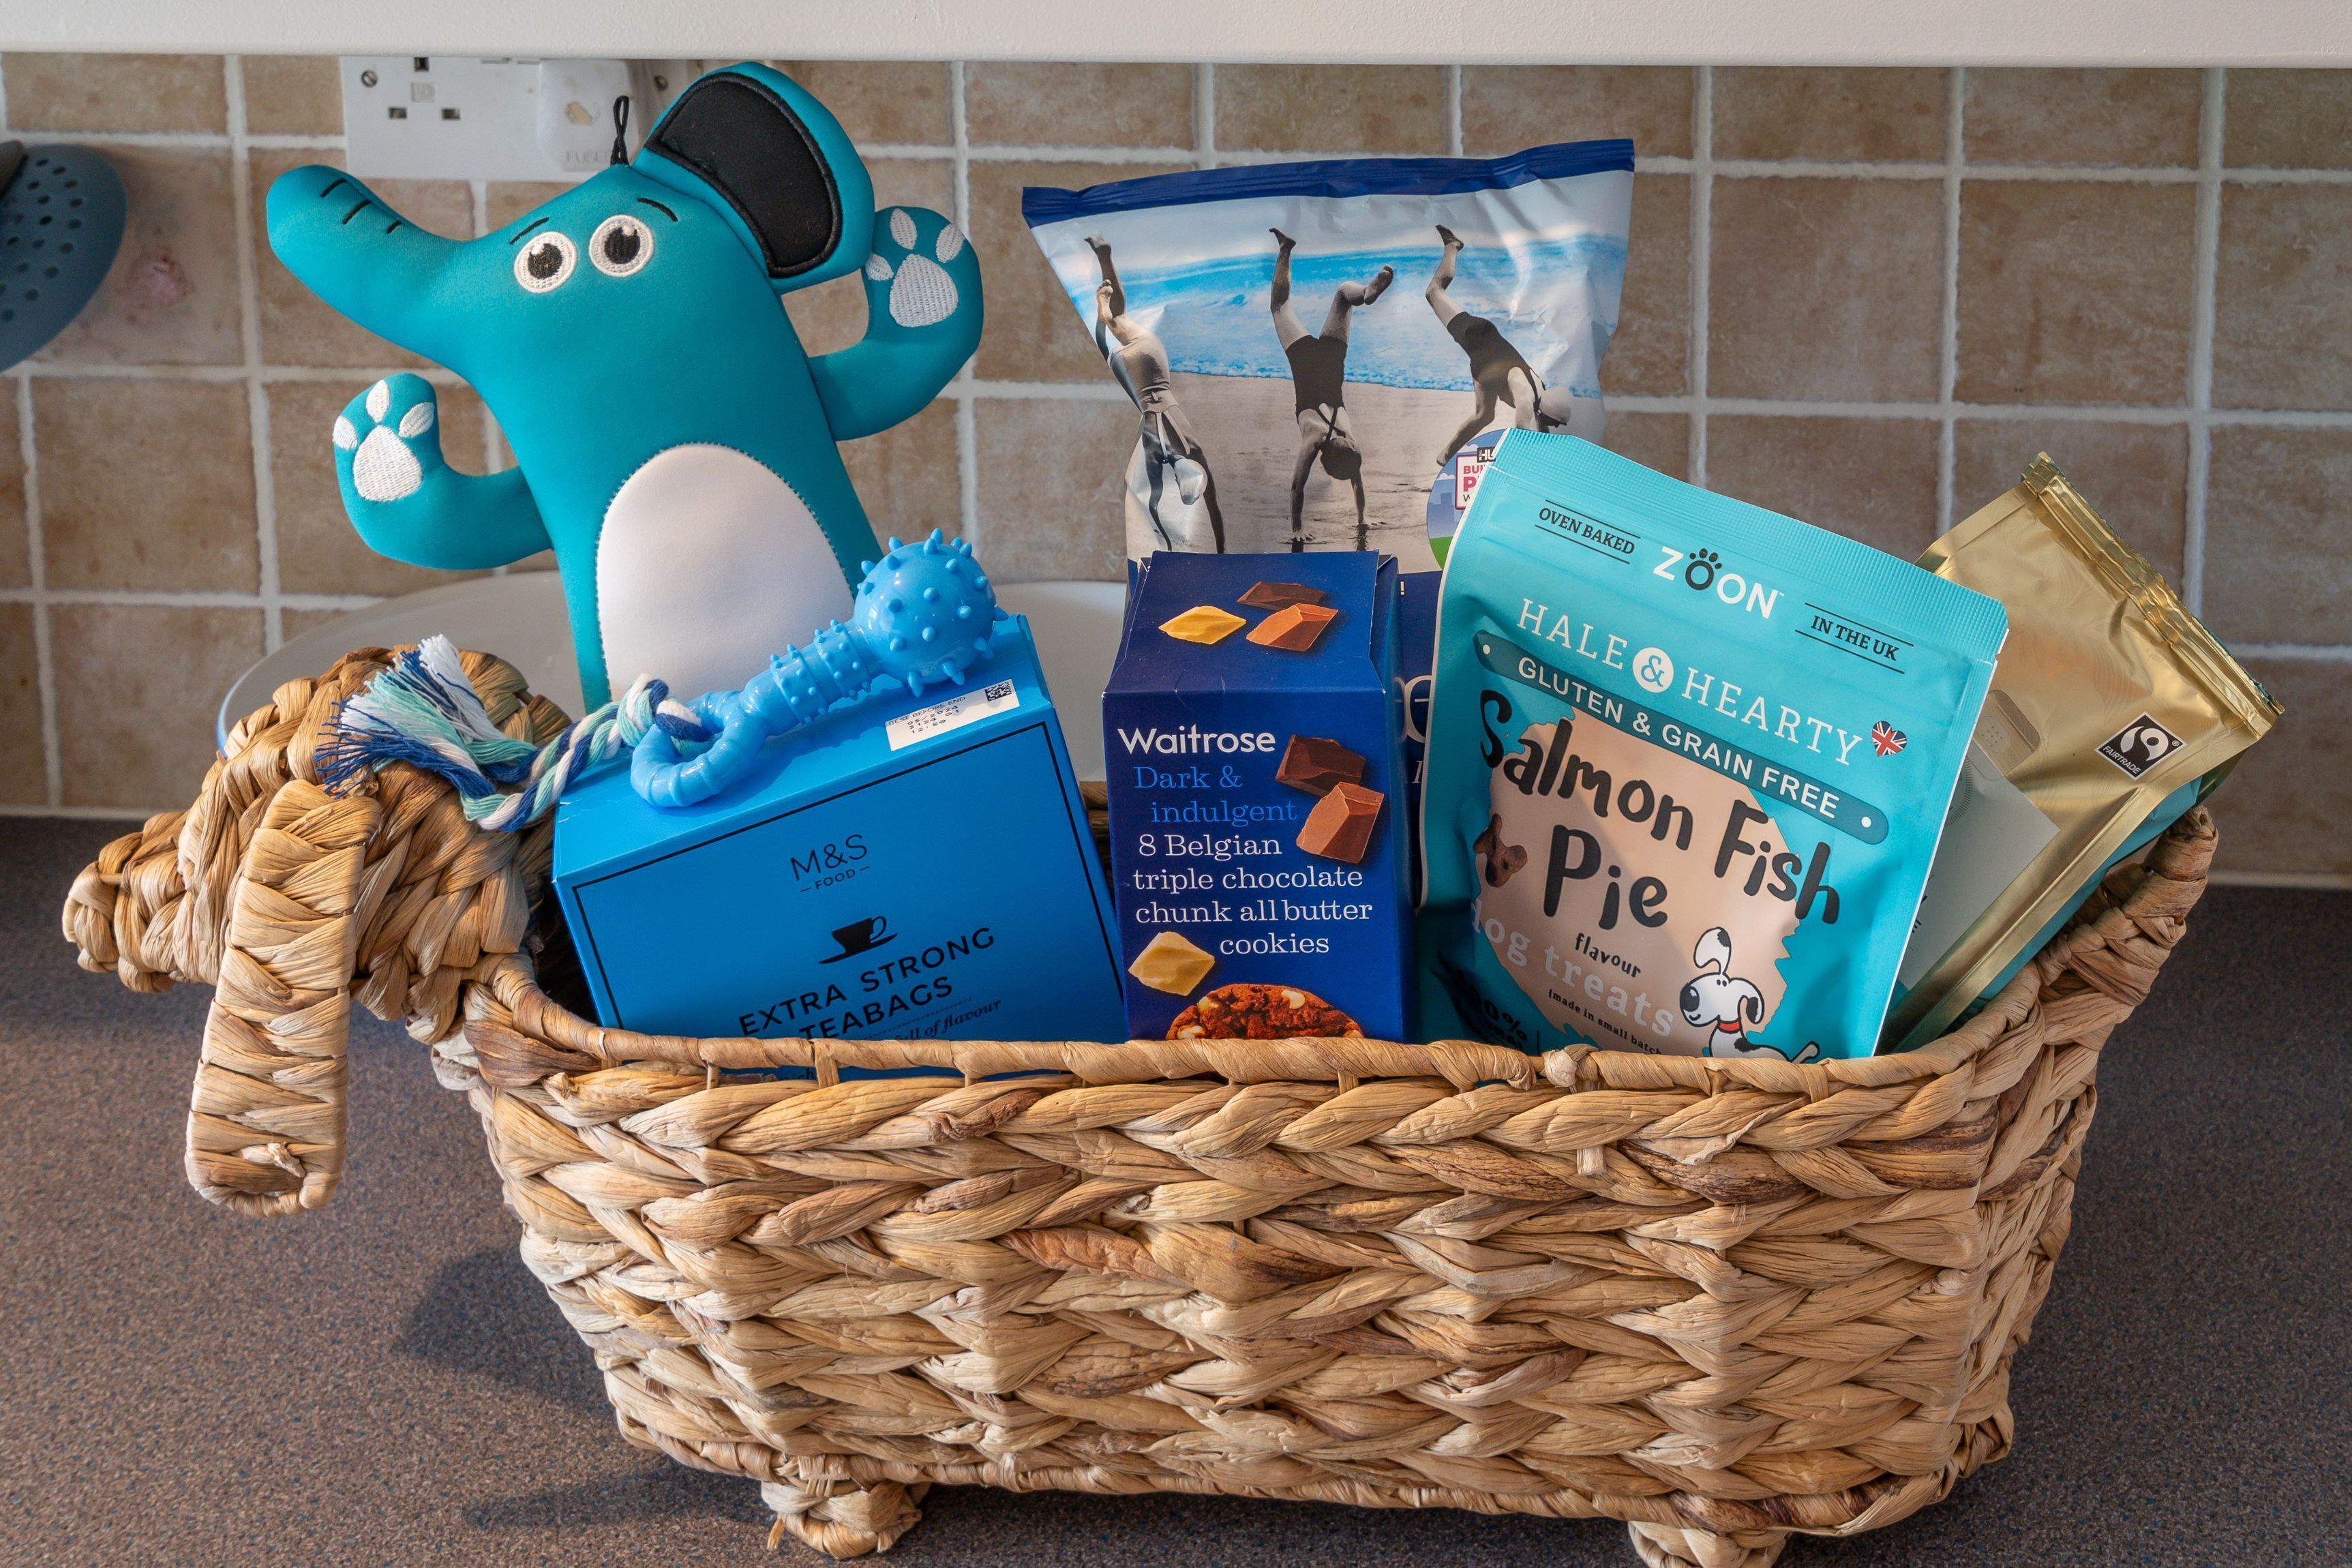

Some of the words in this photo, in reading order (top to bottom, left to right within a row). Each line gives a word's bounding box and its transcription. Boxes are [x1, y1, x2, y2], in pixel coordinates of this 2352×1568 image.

[1539, 507, 1582, 534] OVEN
[1582, 524, 1635, 555] BAKED
[1653, 546, 1779, 619] ZOON
[1810, 615, 1834, 635] IN
[1835, 624, 1871, 650] THE
[1873, 639, 1900, 661] UK
[1517, 598, 1629, 669] HALE
[1638, 652, 1668, 688] &
[1681, 666, 1865, 766] HEARTY
[888, 715, 910, 726] BEST
[912, 703, 946, 718] BEFORE
[948, 696, 967, 706] END
[1117, 724, 1276, 755] Waitrose
[1518, 656, 1623, 721] GLUTEN
[1633, 710, 1652, 736] &
[1662, 723, 1753, 781] GRAIN
[1762, 768, 1841, 819] FREE
[1134, 766, 1210, 789] Dark
[1219, 765, 1243, 789] &
[2102, 745, 2141, 774] FAIRTRADE
[1151, 800, 1297, 827] indulgent
[1479, 688, 1695, 851] Salmon
[1713, 798, 1840, 925] Fish
[791, 834, 867, 881] M&S
[1139, 834, 1156, 856] 8
[1165, 834, 1282, 862] Belgian
[815, 869, 856, 890] FOOD
[1133, 868, 1213, 896] triple
[1222, 866, 1363, 889] chocolate
[1543, 824, 1668, 931] Pie
[1135, 901, 1233, 923] chunk
[1239, 901, 1278, 922] all
[1284, 899, 1374, 922] butter
[1220, 932, 1330, 956] cookies
[1575, 933, 1642, 978] flavour
[738, 984, 848, 1037] EXTRA
[860, 927, 995, 993] STRONG
[1543, 945, 1675, 1037] treats
[798, 976, 953, 1040] TEABAGS
[924, 1019, 941, 1038] of
[941, 998, 1003, 1034] flavour
[1583, 1008, 1595, 1022] in
[1597, 1018, 1628, 1040] small
